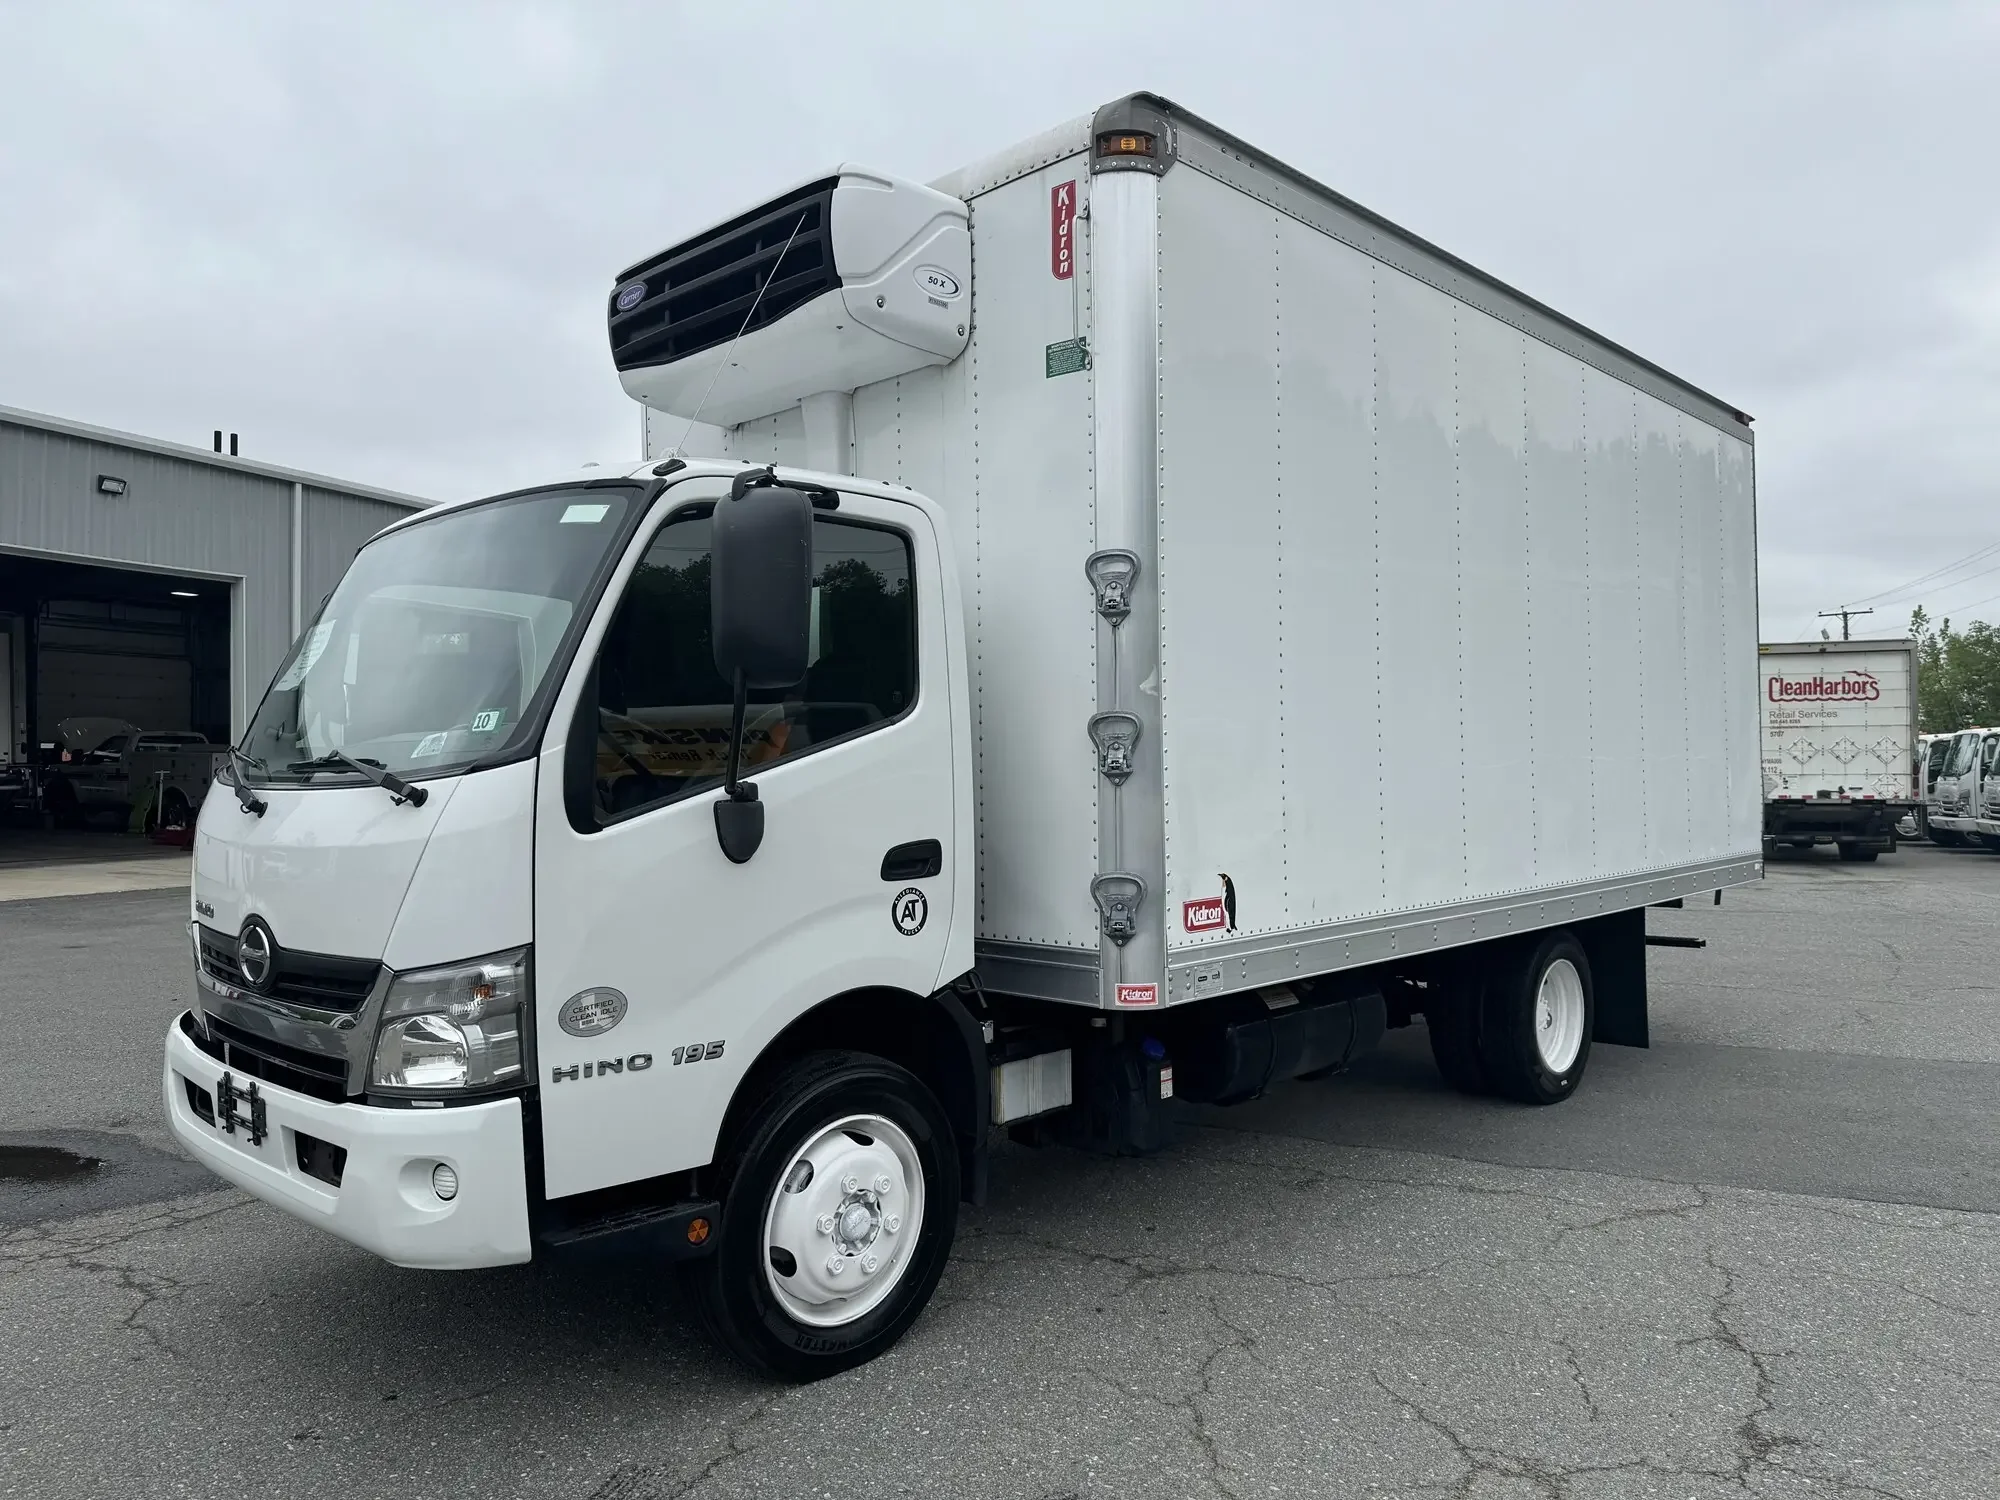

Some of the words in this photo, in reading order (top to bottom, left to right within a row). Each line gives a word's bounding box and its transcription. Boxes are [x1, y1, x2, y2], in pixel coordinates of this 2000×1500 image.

[1057, 185, 1070, 273] Kidron
[928, 276, 939, 285] 50
[939, 280, 946, 288] X
[620, 290, 641, 305] Carrier
[1768, 676, 1880, 702] CleanHarbors
[473, 713, 491, 729] 10
[1769, 710, 1795, 719] Retail
[1798, 710, 1838, 719] Services
[1187, 904, 1221, 927] Kidron
[1121, 988, 1153, 1001] Kidron
[569, 1011, 597, 1023] CLEAN
[600, 1006, 619, 1016] IDLE
[572, 999, 614, 1014] CERTIFIED
[552, 1052, 653, 1083] HINO
[671, 1039, 726, 1066] 195
